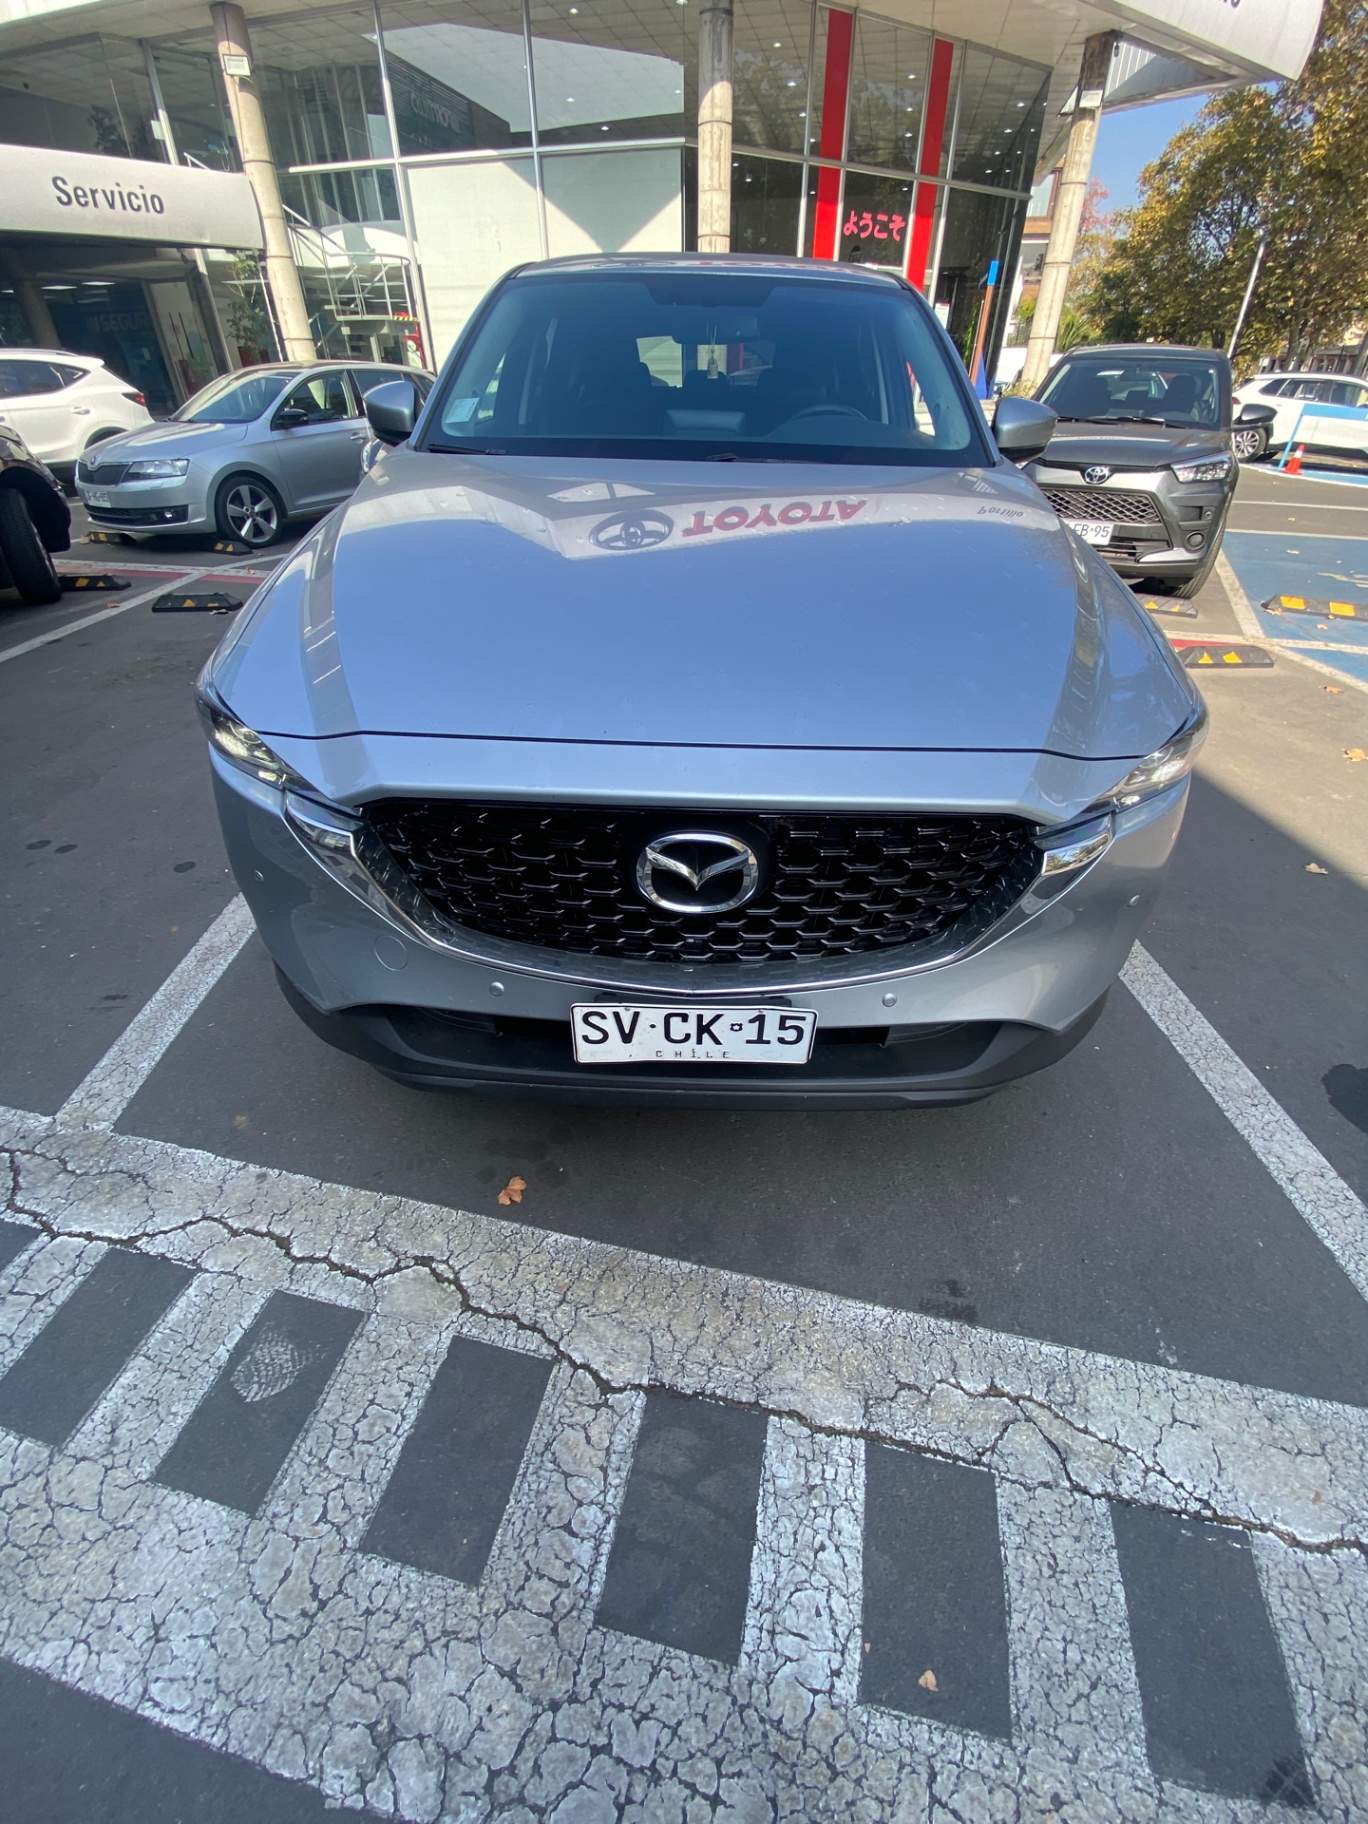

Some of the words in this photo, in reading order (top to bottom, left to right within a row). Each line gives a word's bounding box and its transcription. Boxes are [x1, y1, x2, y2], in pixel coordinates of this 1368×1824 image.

[51, 175, 165, 214] Servicio
[843, 210, 906, 241] ようこそ
[656, 1049, 729, 1059] CHILE
